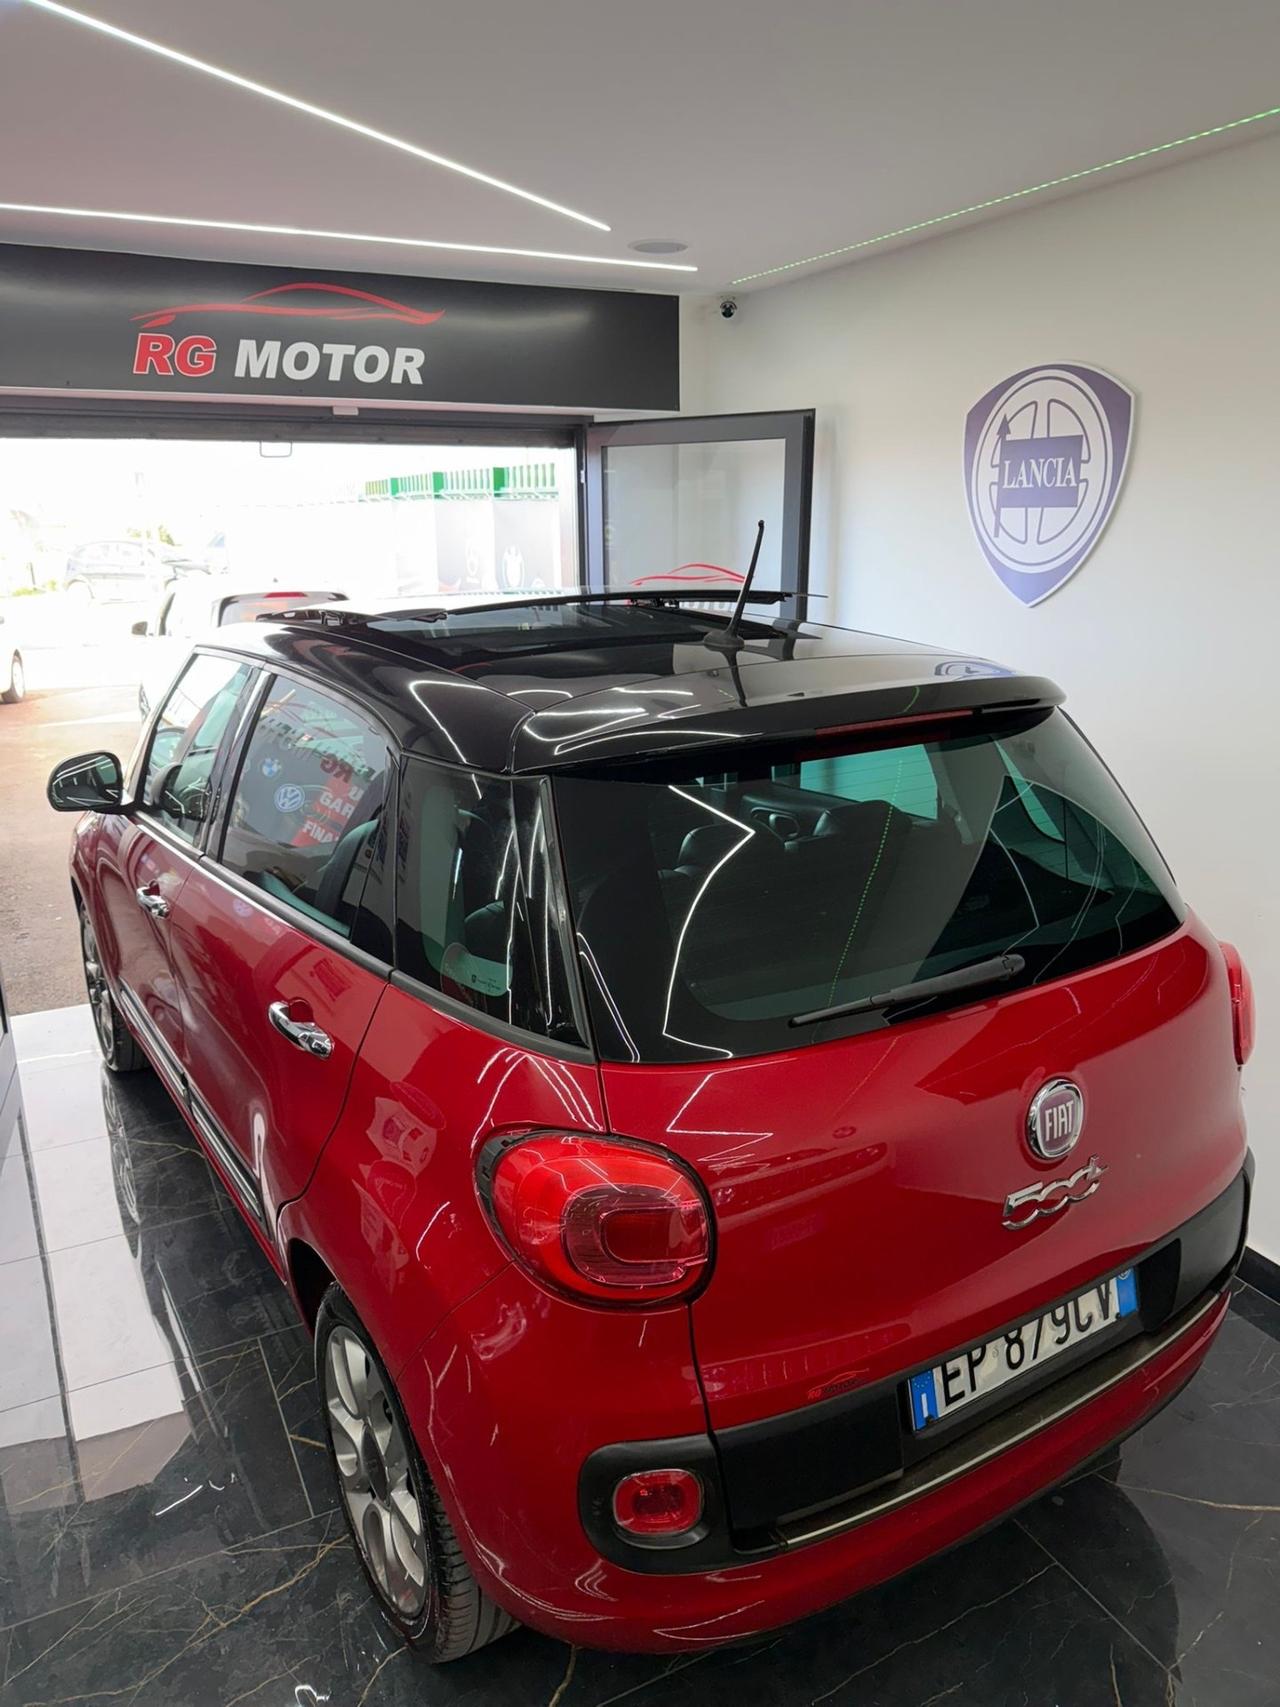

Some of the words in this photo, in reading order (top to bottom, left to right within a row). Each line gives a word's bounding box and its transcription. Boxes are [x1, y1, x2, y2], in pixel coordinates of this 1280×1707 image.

[133, 333, 217, 377] RG
[234, 339, 426, 385] MOTOR
[1002, 457, 1077, 489] LANCIA
[1045, 1101, 1074, 1141] FIAT
[941, 1347, 987, 1407] EP
